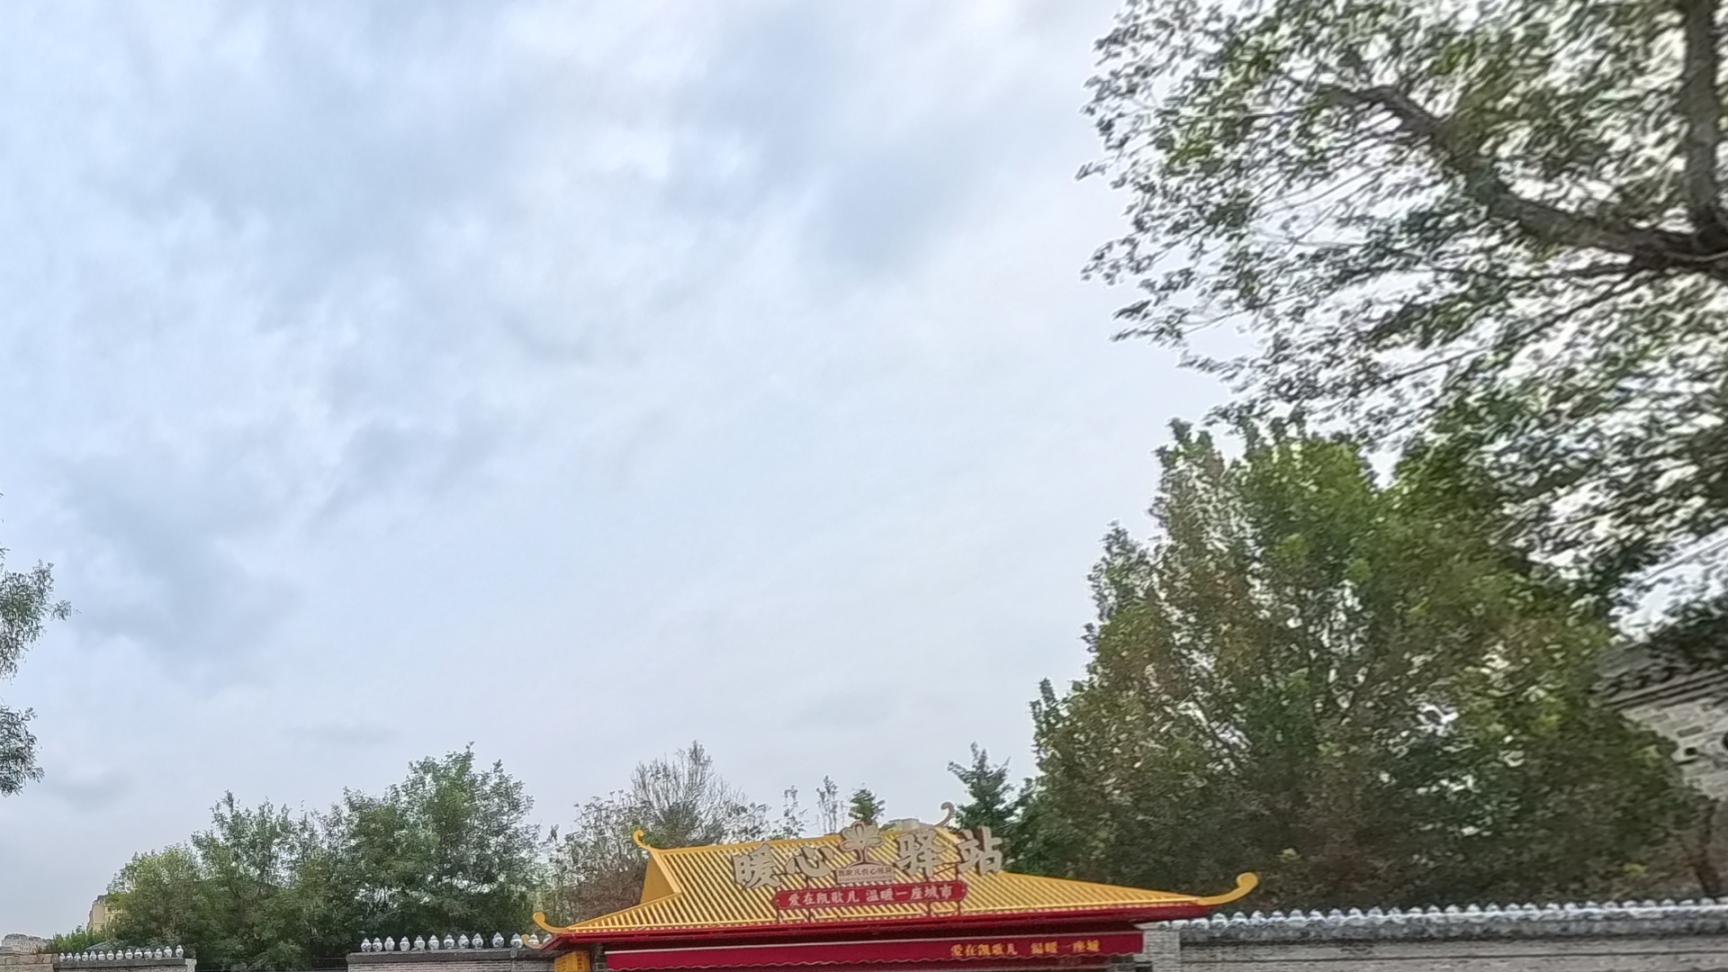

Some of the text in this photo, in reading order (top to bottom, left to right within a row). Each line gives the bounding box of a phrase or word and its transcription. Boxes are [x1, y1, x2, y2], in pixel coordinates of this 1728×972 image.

[733, 826, 1004, 889] 暖心 驿站
[866, 884, 953, 902] 温暖一座城市
